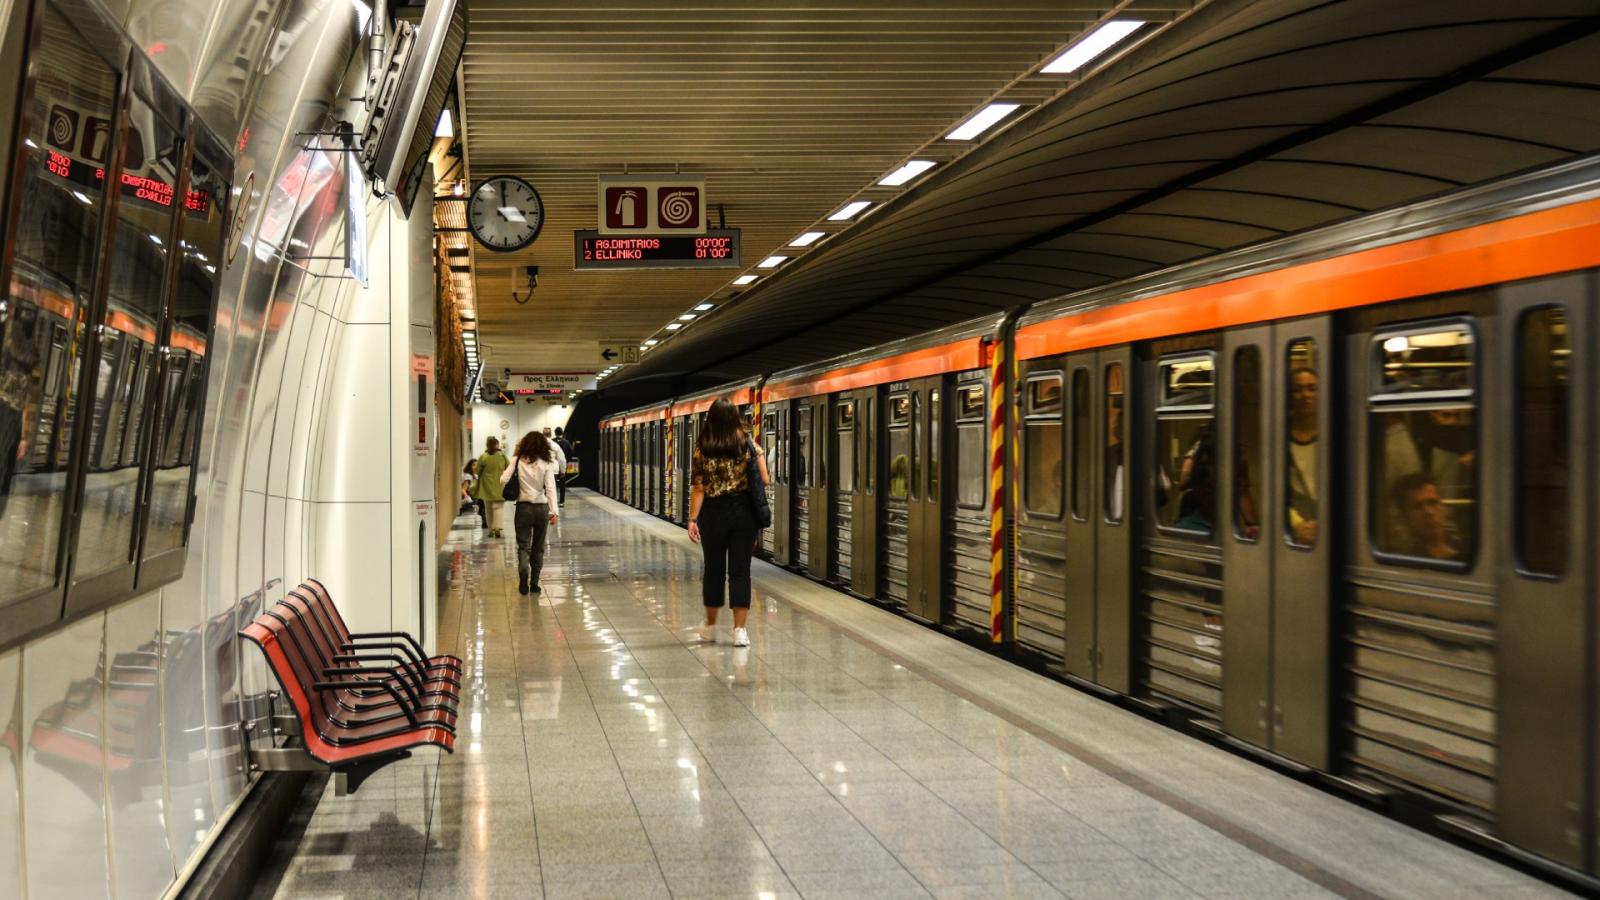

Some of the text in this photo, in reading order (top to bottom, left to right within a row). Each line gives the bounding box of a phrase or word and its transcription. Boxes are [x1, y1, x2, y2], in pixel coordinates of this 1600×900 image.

[585, 240, 589, 249] 1
[595, 239, 660, 249] AG.DIMITRIOS
[584, 250, 592, 260] 2
[595, 250, 642, 260] ELLINIKO
